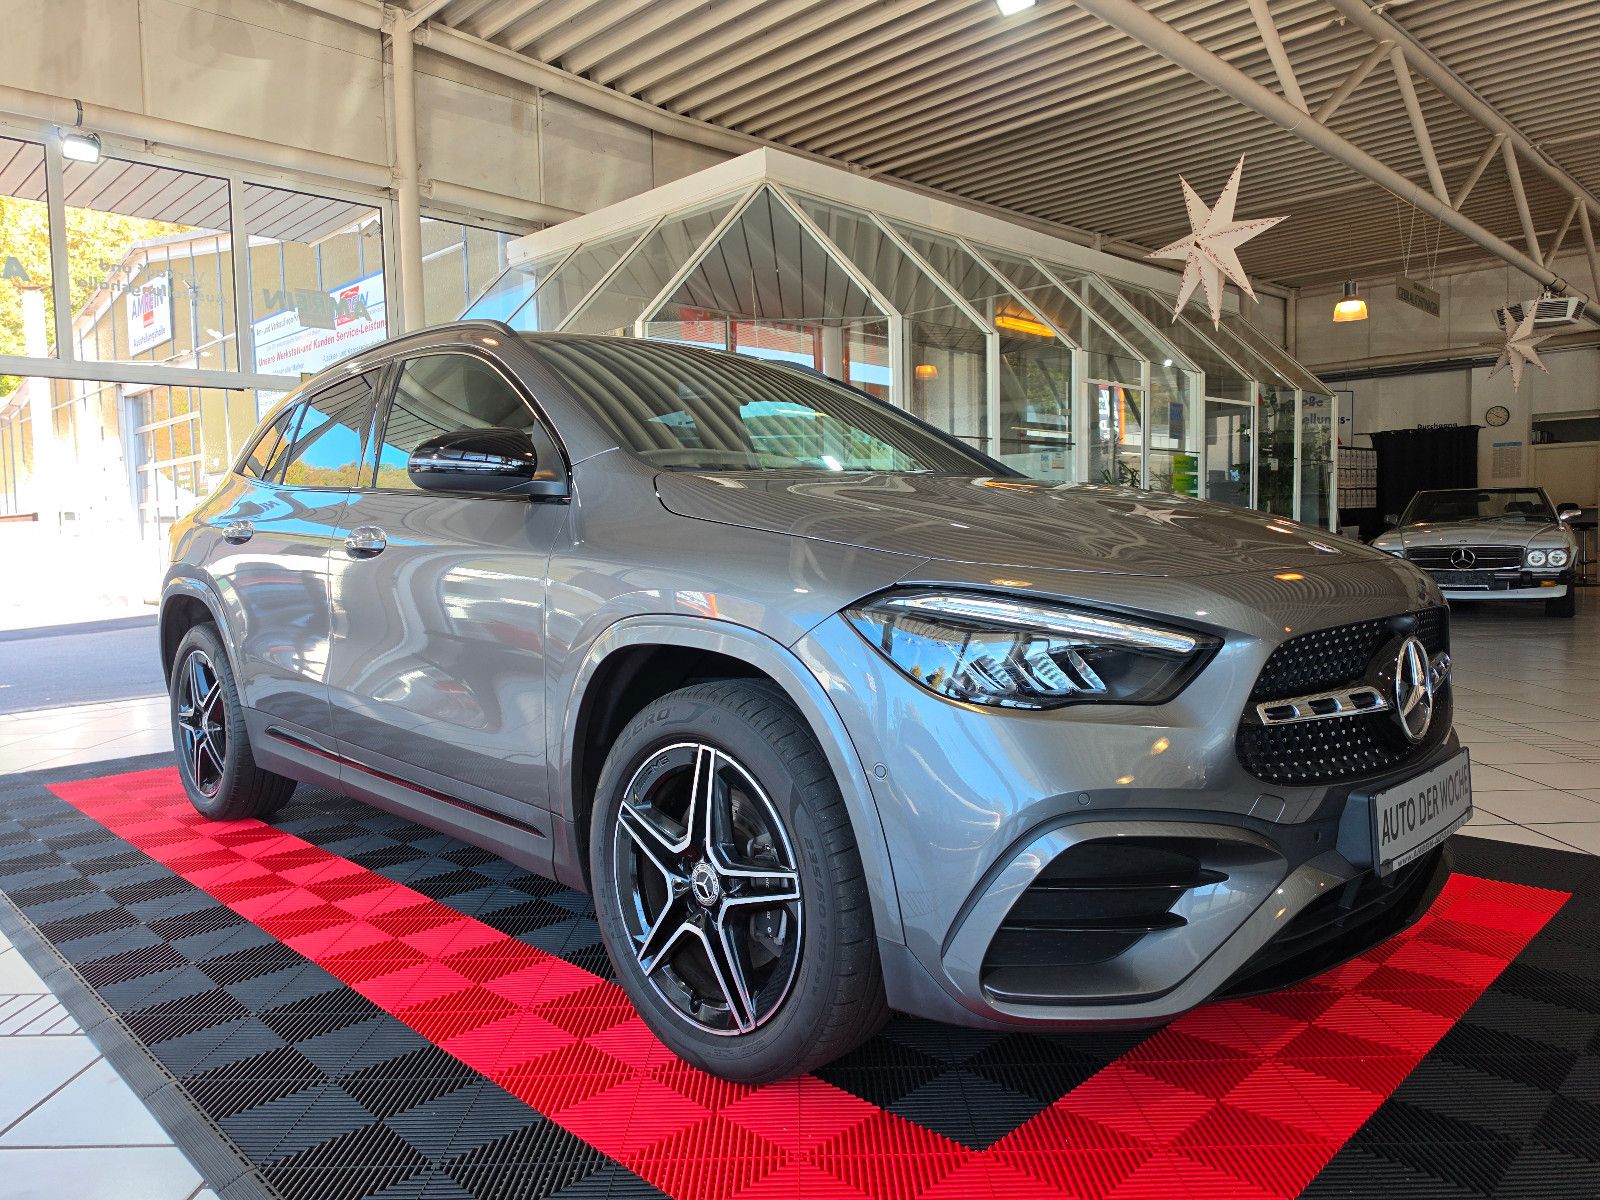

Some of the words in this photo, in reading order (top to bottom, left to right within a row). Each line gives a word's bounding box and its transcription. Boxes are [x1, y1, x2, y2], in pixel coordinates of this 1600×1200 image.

[1381, 797, 1416, 846] AUTO
[1418, 784, 1440, 826] DER
[1439, 764, 1469, 811] WOCHE
